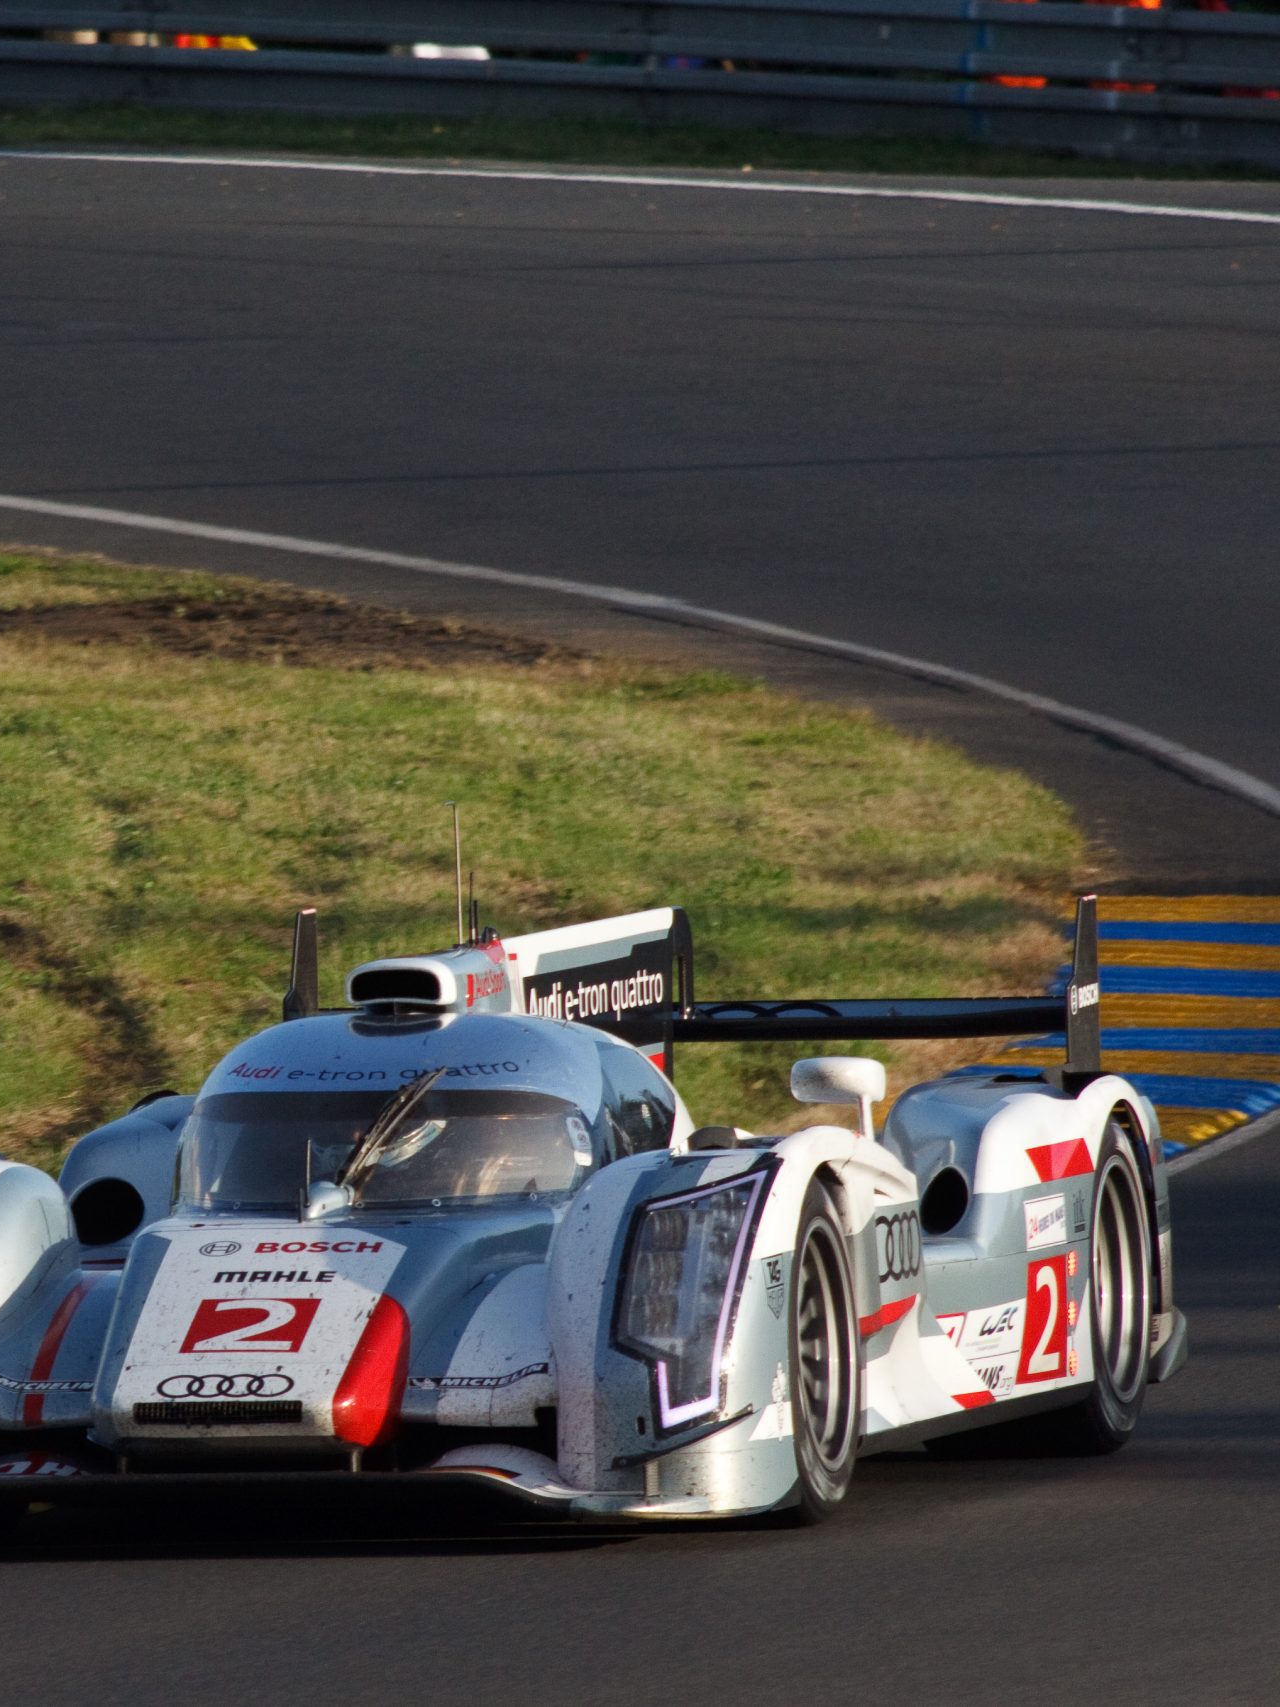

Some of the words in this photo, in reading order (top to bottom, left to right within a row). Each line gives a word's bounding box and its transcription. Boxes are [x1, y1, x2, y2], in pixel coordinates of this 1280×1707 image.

[529, 981, 562, 1019] Audi
[565, 981, 608, 1020] e-tron
[611, 969, 663, 1022] quattro
[1078, 982, 1099, 1008] BOSCH
[227, 1062, 284, 1079] Audi
[287, 1067, 386, 1081] e-tron
[255, 1241, 384, 1254] BOSCH
[213, 1271, 336, 1283] MAHLE
[192, 1299, 297, 1351] 2
[979, 1306, 1018, 1336] WEC
[1027, 1265, 1060, 1375] 2
[440, 1363, 545, 1387] MICHELIN
